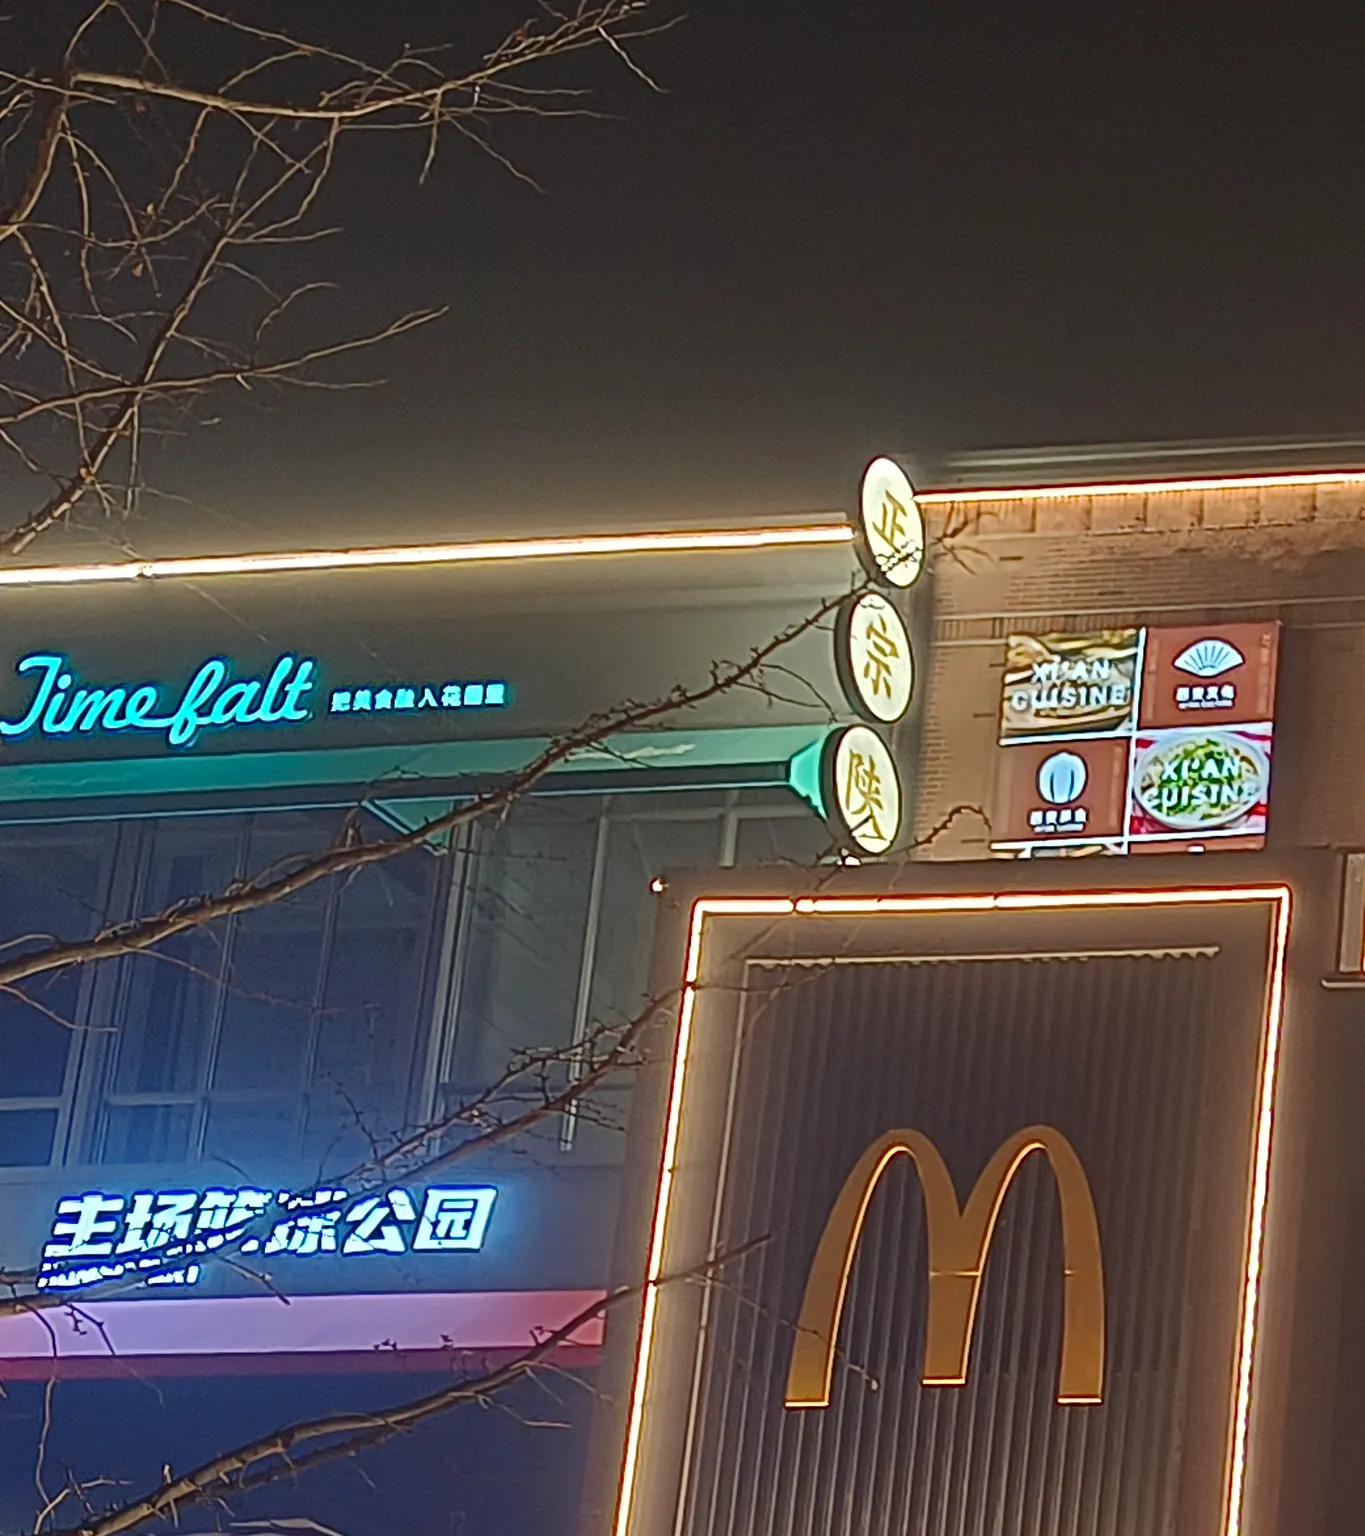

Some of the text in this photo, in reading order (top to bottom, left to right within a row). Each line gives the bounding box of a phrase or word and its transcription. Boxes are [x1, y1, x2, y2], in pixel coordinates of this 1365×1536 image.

[1011, 685, 1128, 710] CUISINE
[44, 1185, 498, 1257] 主场篮球公园
